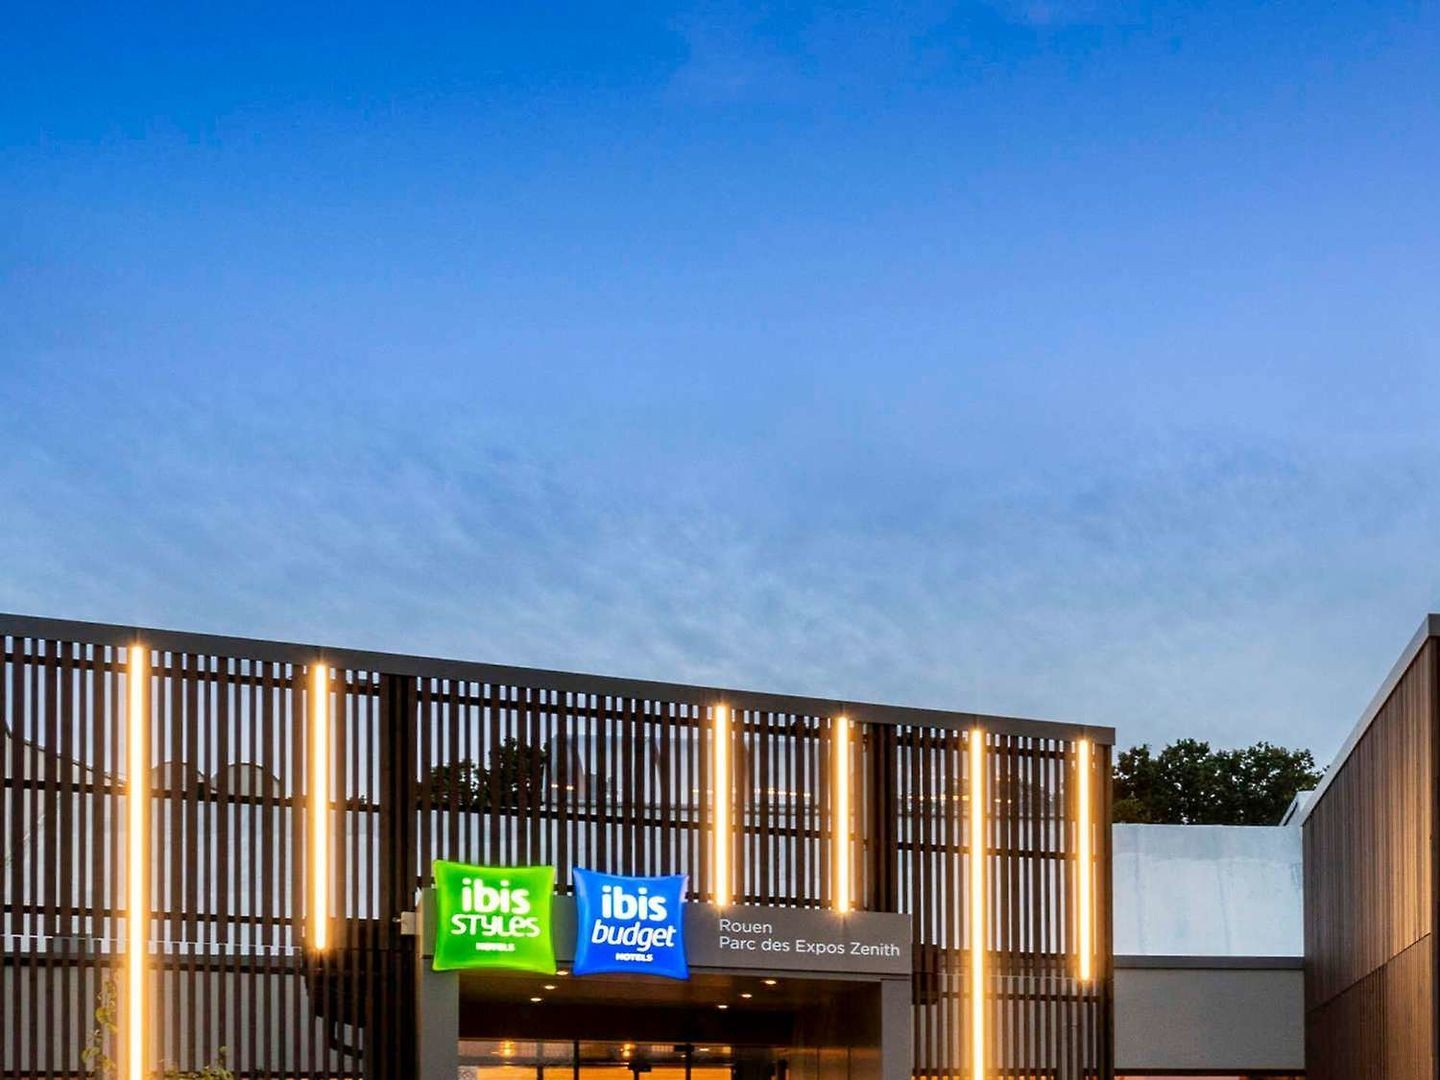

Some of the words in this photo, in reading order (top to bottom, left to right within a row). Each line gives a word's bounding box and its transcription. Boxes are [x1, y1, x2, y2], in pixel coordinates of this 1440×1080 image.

[462, 877, 531, 914] ibis
[602, 885, 667, 921] ibis
[591, 919, 677, 952] budget
[719, 918, 773, 934] Rouen
[719, 936, 756, 950] Parc
[761, 938, 790, 952] des
[795, 939, 845, 955] Expos
[850, 942, 900, 956] Zenith
